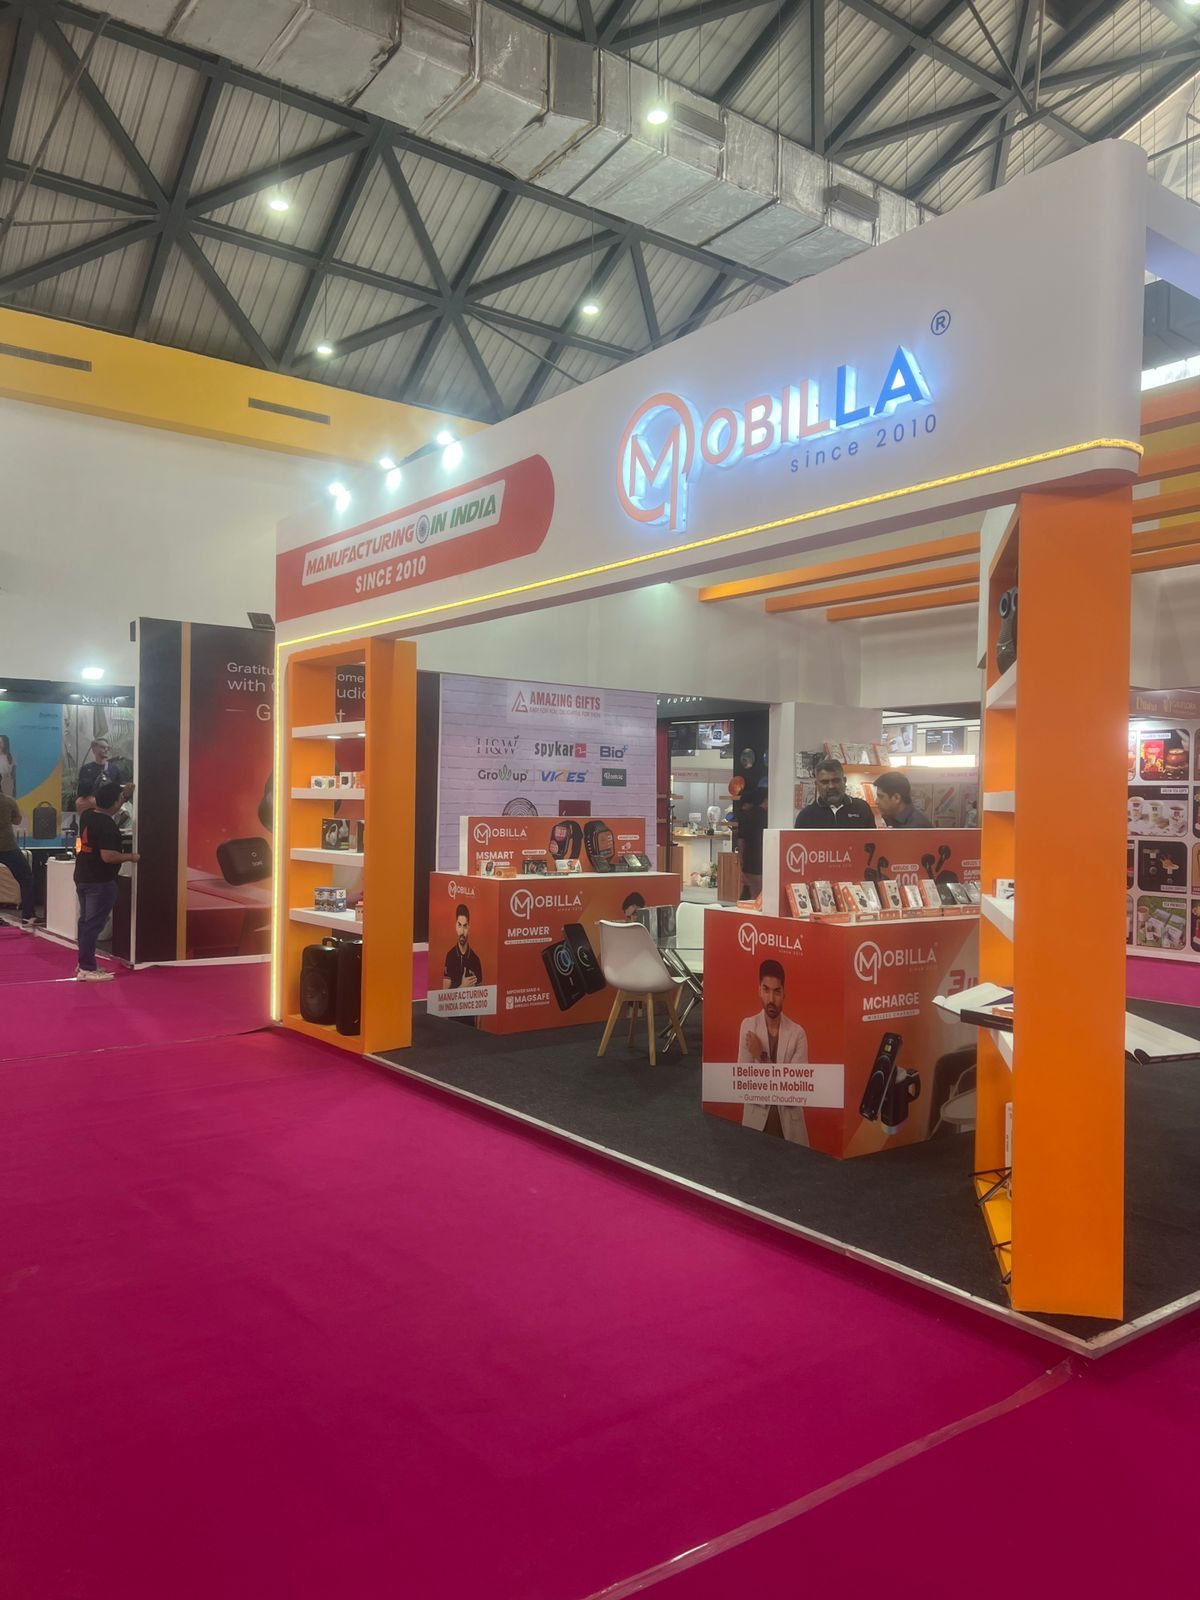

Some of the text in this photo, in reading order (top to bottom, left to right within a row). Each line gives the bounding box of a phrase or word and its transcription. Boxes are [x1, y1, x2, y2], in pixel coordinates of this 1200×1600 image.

[616, 345, 934, 533] MOBILLA
[790, 414, 938, 473] since 2010
[306, 495, 497, 576] MANUFACTURING IN INDIA
[355, 555, 427, 593] SINCE 2010
[226, 662, 275, 676] Gratitu
[227, 678, 266, 693] with
[530, 691, 601, 711] AMAZING GIFTS
[534, 741, 574, 757] spykar
[473, 823, 527, 846] MOBILLA
[476, 851, 514, 861] MSMART
[786, 843, 852, 876] MOBILLA
[510, 889, 582, 920] MOBILLA
[507, 926, 550, 937] MPOWER
[738, 923, 803, 955] MOBILLA
[854, 941, 937, 985] MOBILLA
[438, 989, 489, 1001] MANUFACTURING
[514, 993, 550, 1003] MAGSAFE
[863, 992, 920, 1010] MCHARGE
[737, 1066, 770, 1077] Believe
[772, 1066, 781, 1077] in
[783, 1067, 814, 1078] Power
[737, 1080, 768, 1090] Believe
[770, 1080, 778, 1091] in
[780, 1081, 814, 1091] Mobilla
